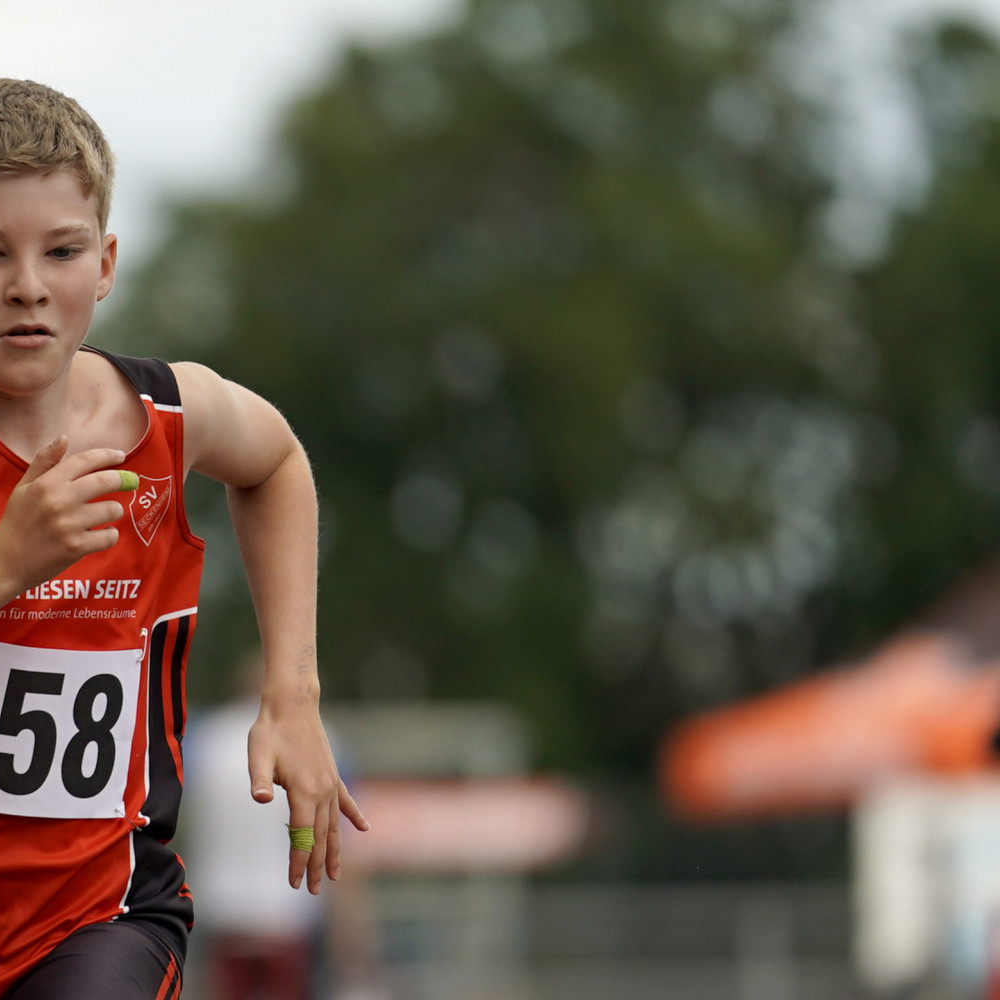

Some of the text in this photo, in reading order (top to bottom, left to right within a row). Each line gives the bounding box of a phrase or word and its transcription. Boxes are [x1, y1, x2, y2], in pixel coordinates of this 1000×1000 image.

[138, 485, 158, 509] SV
[15, 579, 142, 600] LIESEN SEITZ
[9, 607, 26, 620] für
[28, 608, 71, 620] moderne
[73, 607, 137, 619] Lebensräume
